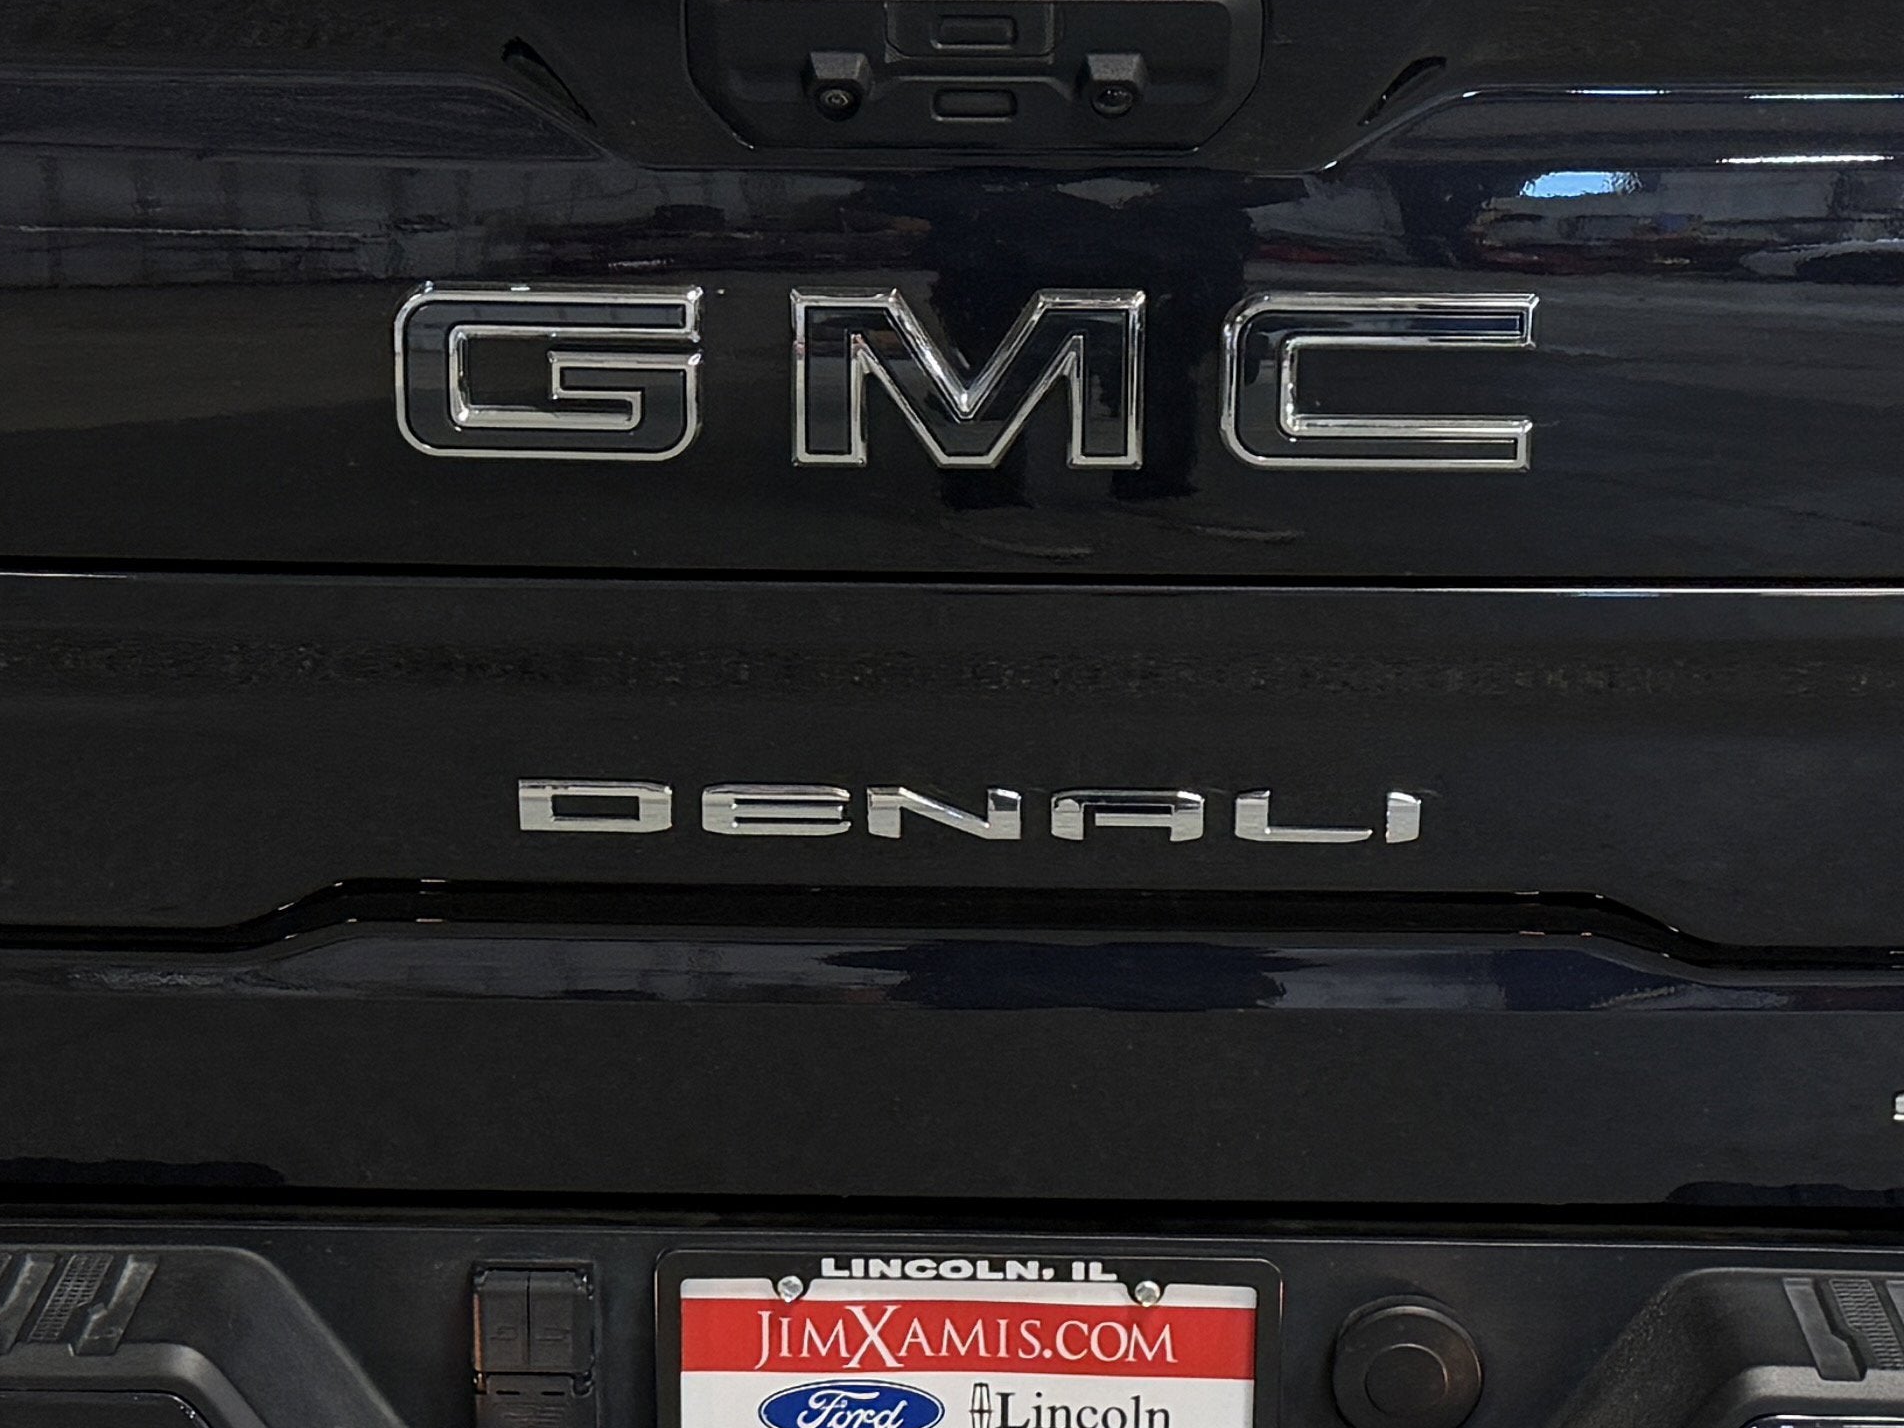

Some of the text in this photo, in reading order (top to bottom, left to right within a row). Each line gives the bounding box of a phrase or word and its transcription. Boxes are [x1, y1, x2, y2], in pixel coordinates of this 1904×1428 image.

[394, 280, 1540, 472] GMC
[516, 779, 1422, 844] DENALI
[821, 1257, 1118, 1282] LINCOLN, IL
